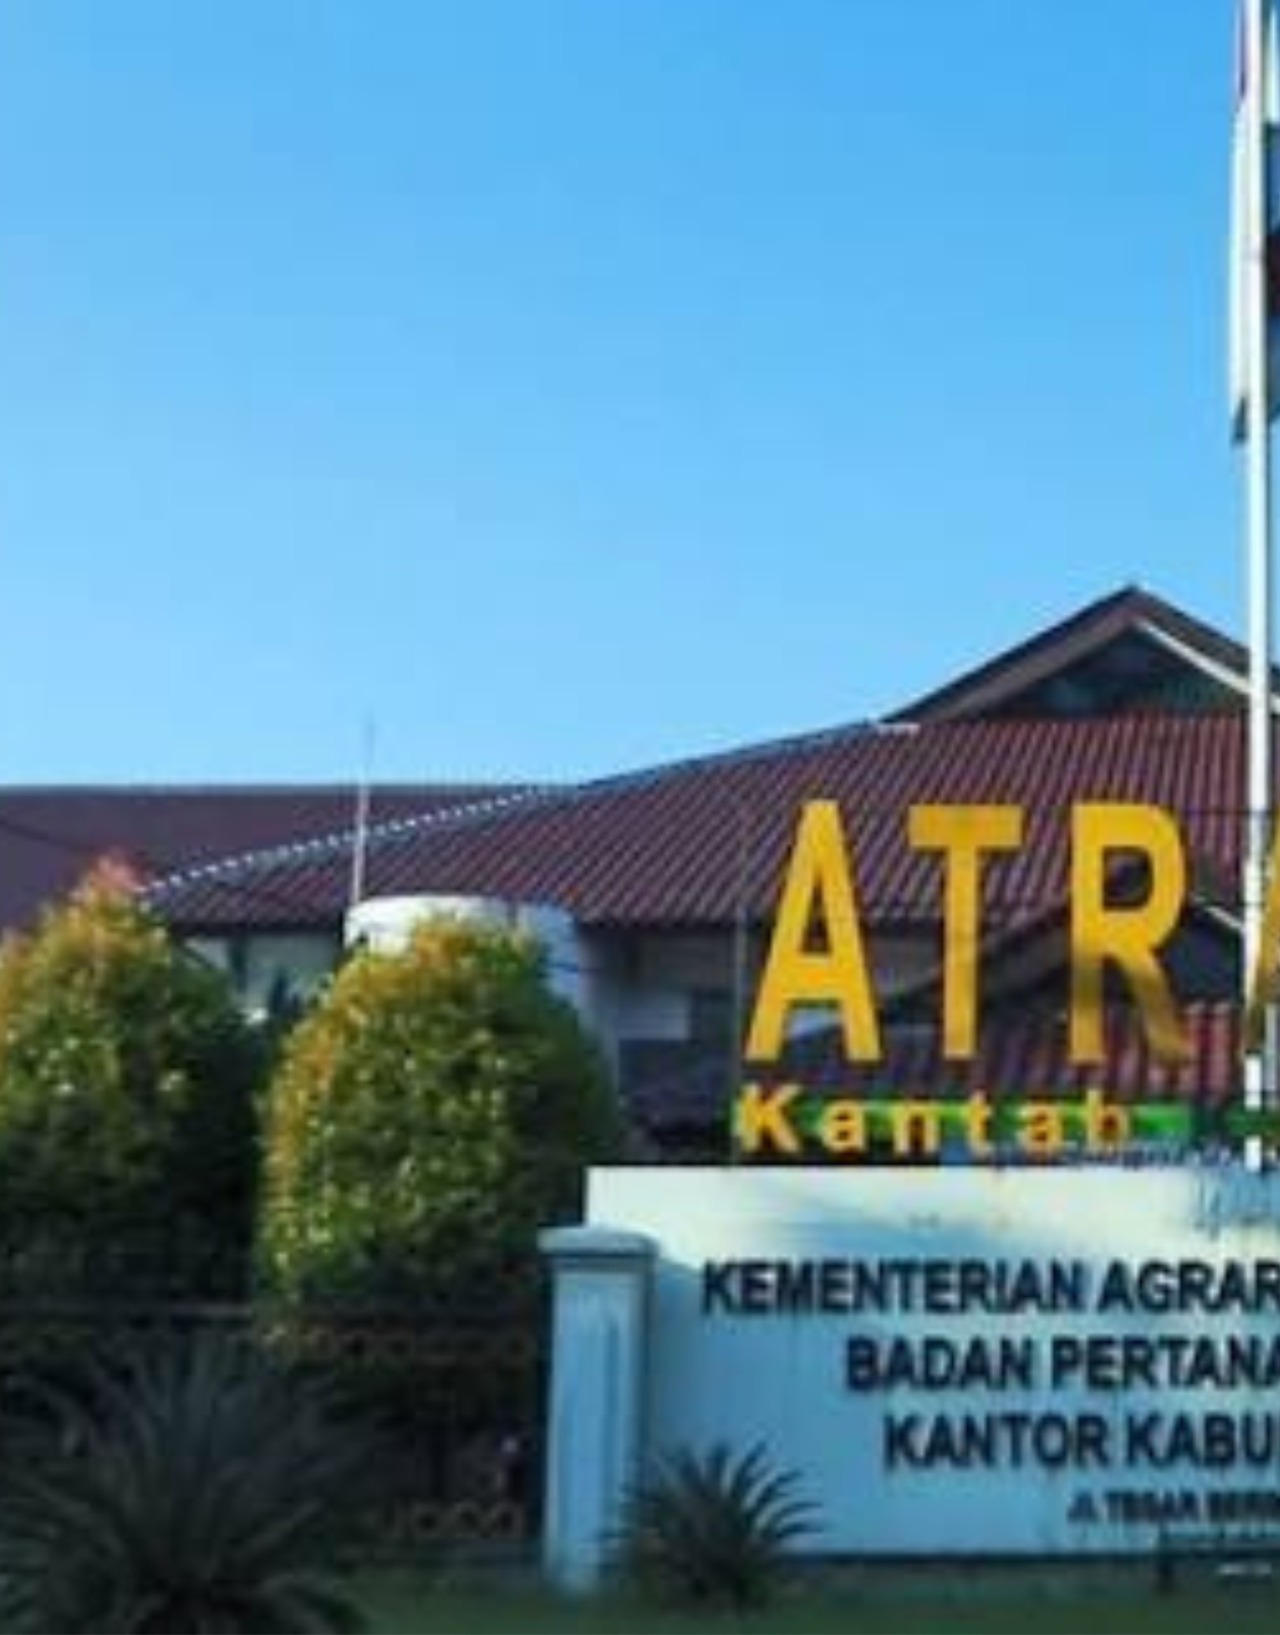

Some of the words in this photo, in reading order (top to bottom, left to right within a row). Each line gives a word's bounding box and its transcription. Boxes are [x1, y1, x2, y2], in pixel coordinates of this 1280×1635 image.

[702, 1258, 1084, 1315] KEMENTERIAN
[845, 1336, 1034, 1391] BADAN
[884, 1414, 1109, 1470] KANTOR
